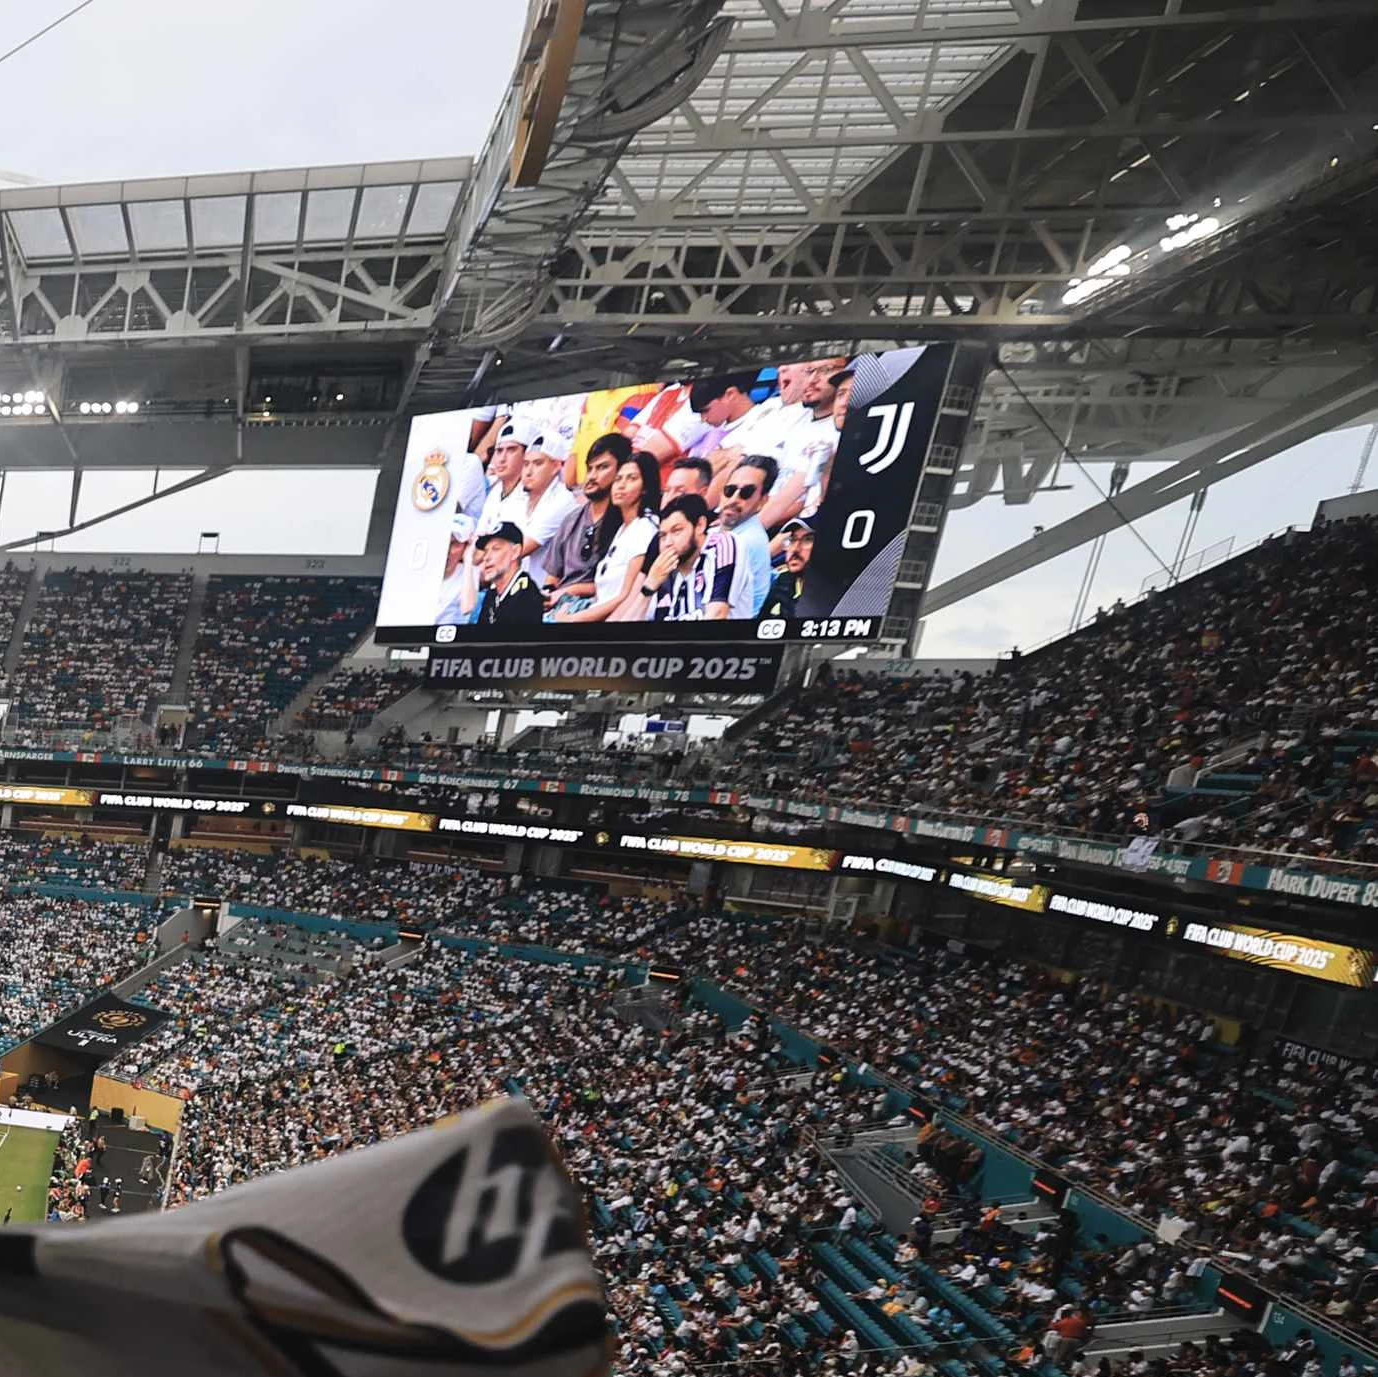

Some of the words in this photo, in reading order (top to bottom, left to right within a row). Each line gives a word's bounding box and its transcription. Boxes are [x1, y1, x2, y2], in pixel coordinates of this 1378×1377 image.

[841, 509, 876, 549] 0
[761, 623, 782, 634] CC
[800, 620, 841, 637] 3:13
[843, 619, 872, 636] PM
[430, 658, 473, 677] FIFA
[478, 658, 534, 677] CLUB
[541, 657, 626, 678] WORLD
[631, 657, 684, 678] CUP
[885, 660, 914, 671] 327
[123, 756, 154, 766] LARRY
[157, 758, 187, 767] LITTLE
[189, 759, 203, 768] 66
[419, 774, 437, 784] BOB
[503, 779, 519, 790] 67
[100, 794, 123, 804] FIFA
[124, 796, 151, 806] CLUB
[152, 798, 192, 808] WORLD
[193, 800, 215, 810] CUP
[580, 785, 635, 798] RICHMOND
[673, 790, 690, 802] 78
[439, 819, 462, 831] FIFA
[462, 821, 487, 833] CLUB
[488, 824, 526, 837] WORLD
[527, 827, 549, 839] CUP
[620, 835, 646, 848] FIFA
[647, 838, 678, 851] CLUB
[680, 840, 725, 855] WORLD
[726, 843, 754, 857] CUP
[1266, 868, 1308, 895] MARK
[1309, 875, 1358, 904] DUPER
[1184, 923, 1208, 942] FIFA
[1207, 927, 1236, 949] CLUB
[1234, 932, 1275, 957] WORLD
[1274, 941, 1299, 963] CUP
[67, 1029, 118, 1045] ULTRA
